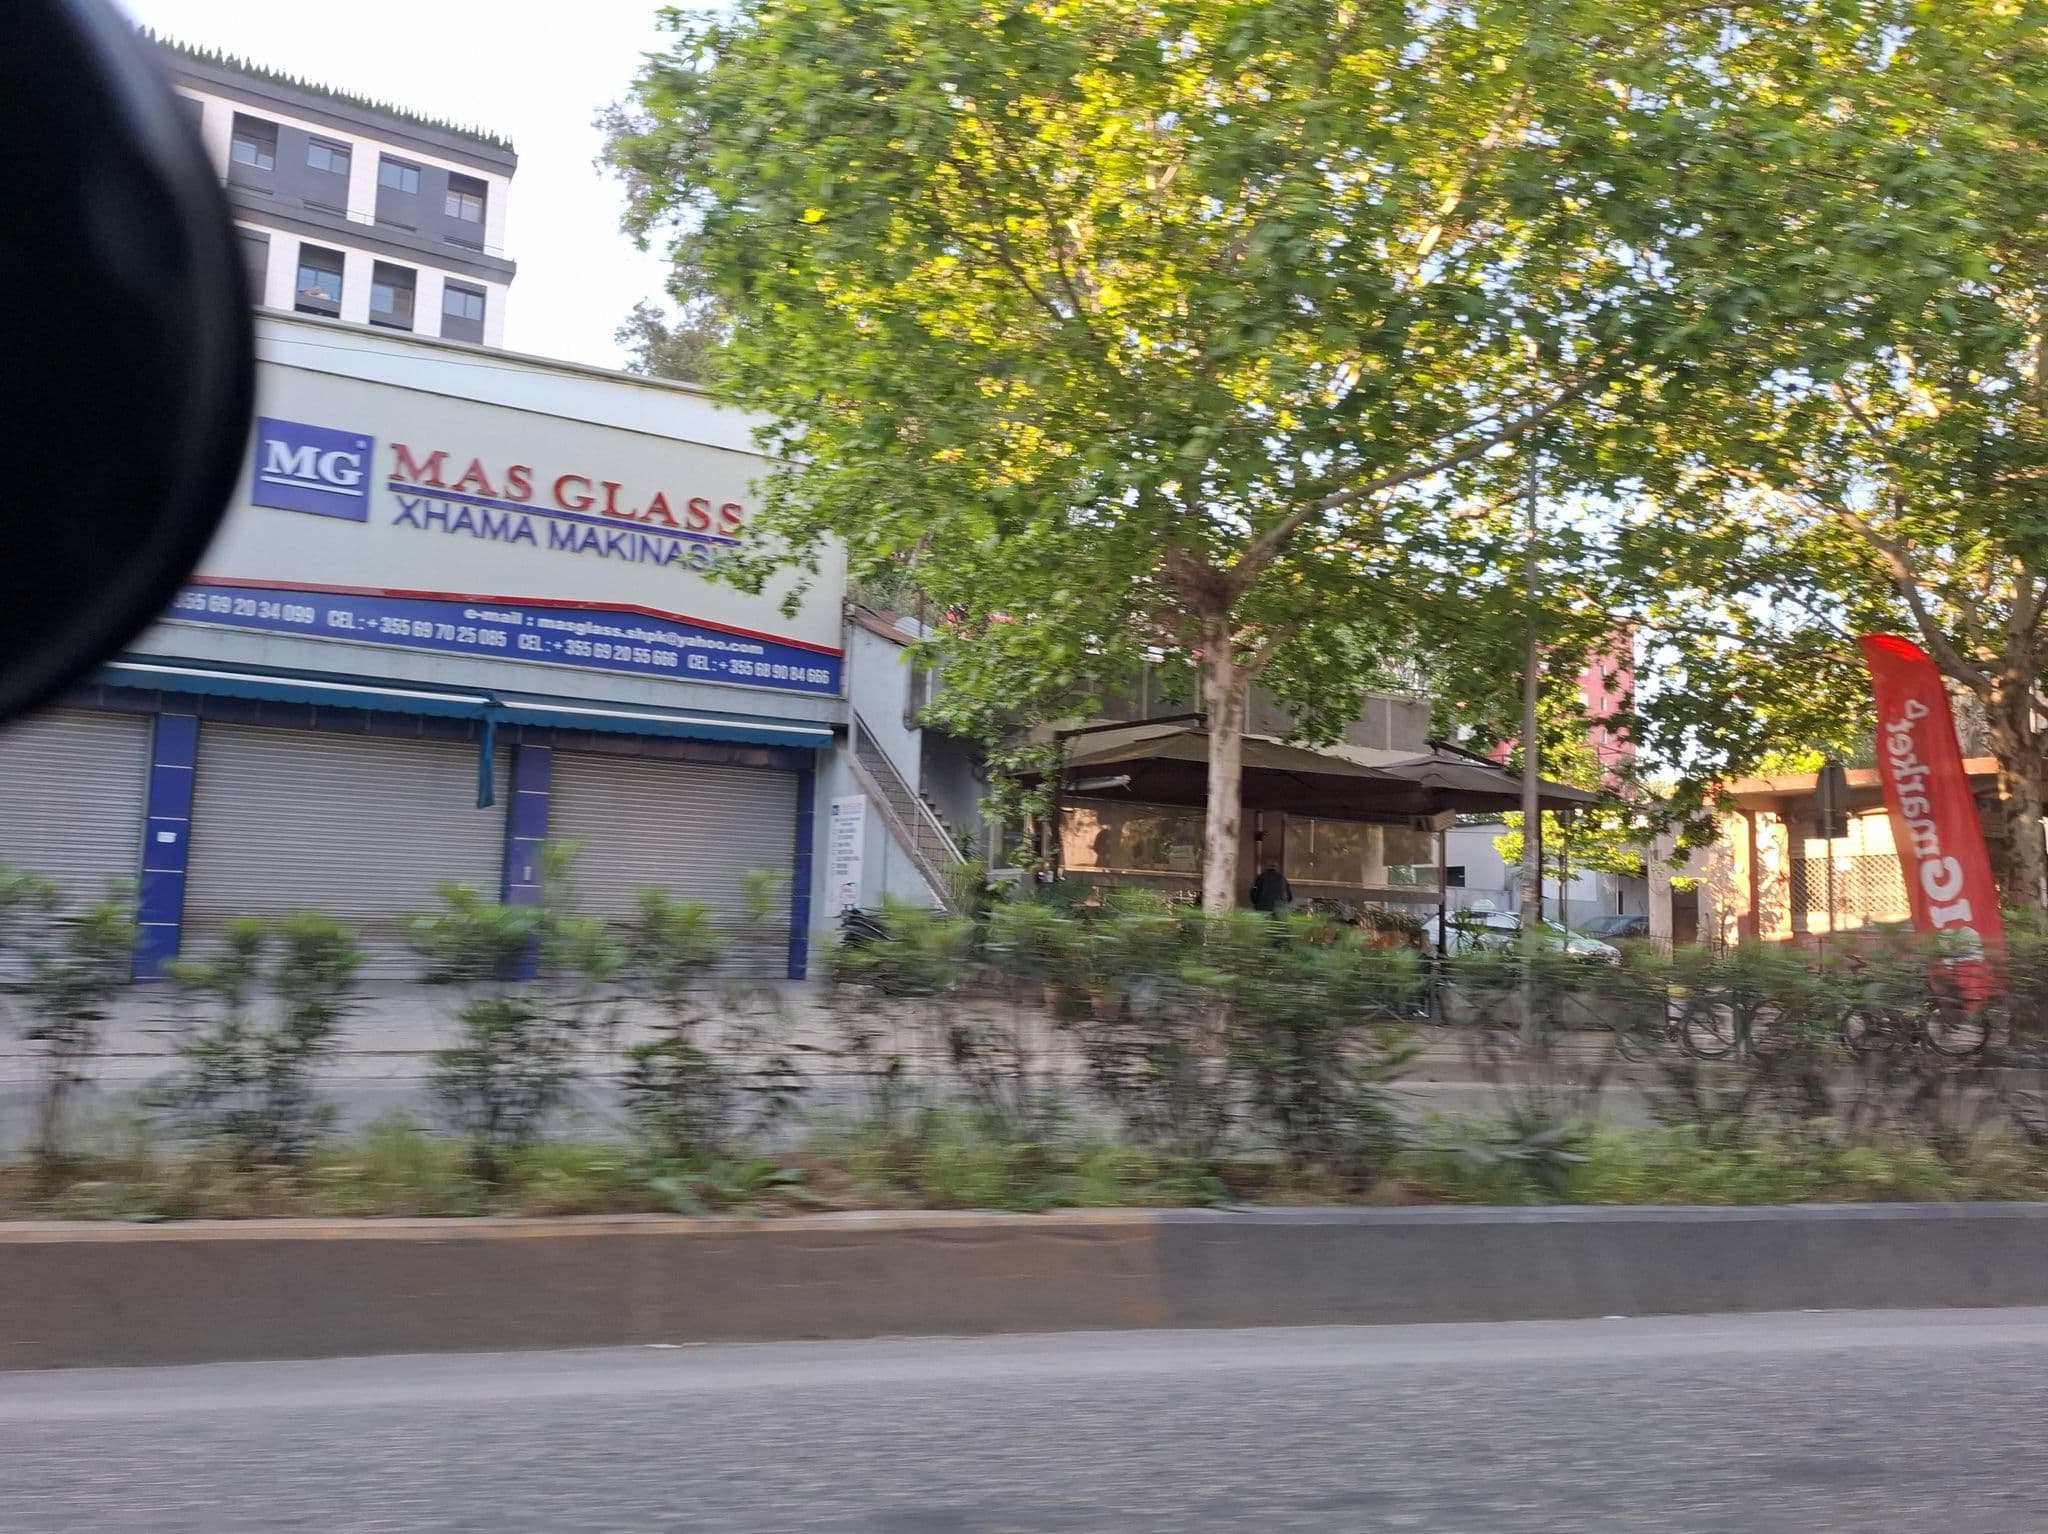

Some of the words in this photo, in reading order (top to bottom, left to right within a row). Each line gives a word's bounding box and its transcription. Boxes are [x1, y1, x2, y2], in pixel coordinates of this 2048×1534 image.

[261, 439, 364, 486] MG
[388, 442, 535, 502] MAS
[553, 473, 743, 536] GLASS
[391, 495, 538, 547] XHAMA
[547, 520, 718, 572] MAKINAS
[208, 595, 233, 614] 69
[232, 598, 257, 617] 20
[257, 601, 281, 620] 34
[411, 620, 434, 639] 69
[434, 623, 455, 641] 70
[456, 626, 477, 644] 25
[593, 642, 612, 660] 69
[612, 645, 632, 662] 20
[632, 647, 651, 664] 55
[463, 608, 523, 625] e-mail
